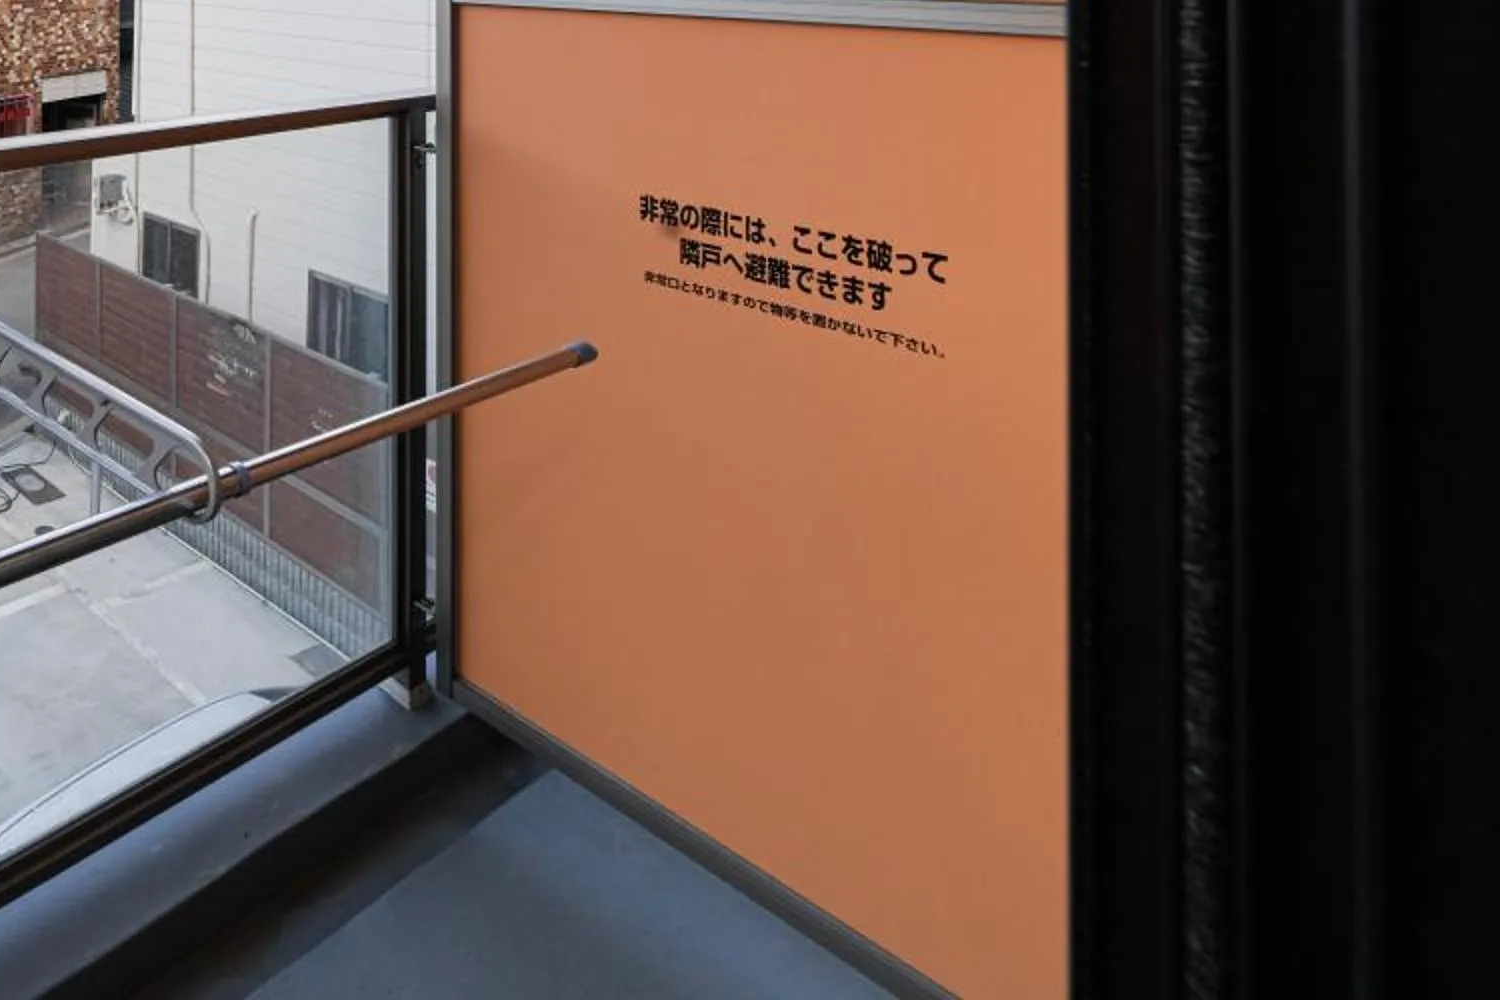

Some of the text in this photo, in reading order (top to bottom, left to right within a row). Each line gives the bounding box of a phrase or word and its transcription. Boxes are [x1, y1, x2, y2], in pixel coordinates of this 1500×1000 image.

[639, 194, 949, 284] 非常の際には、ここを破って
[679, 237, 893, 311] 隣戸へ避難できます
